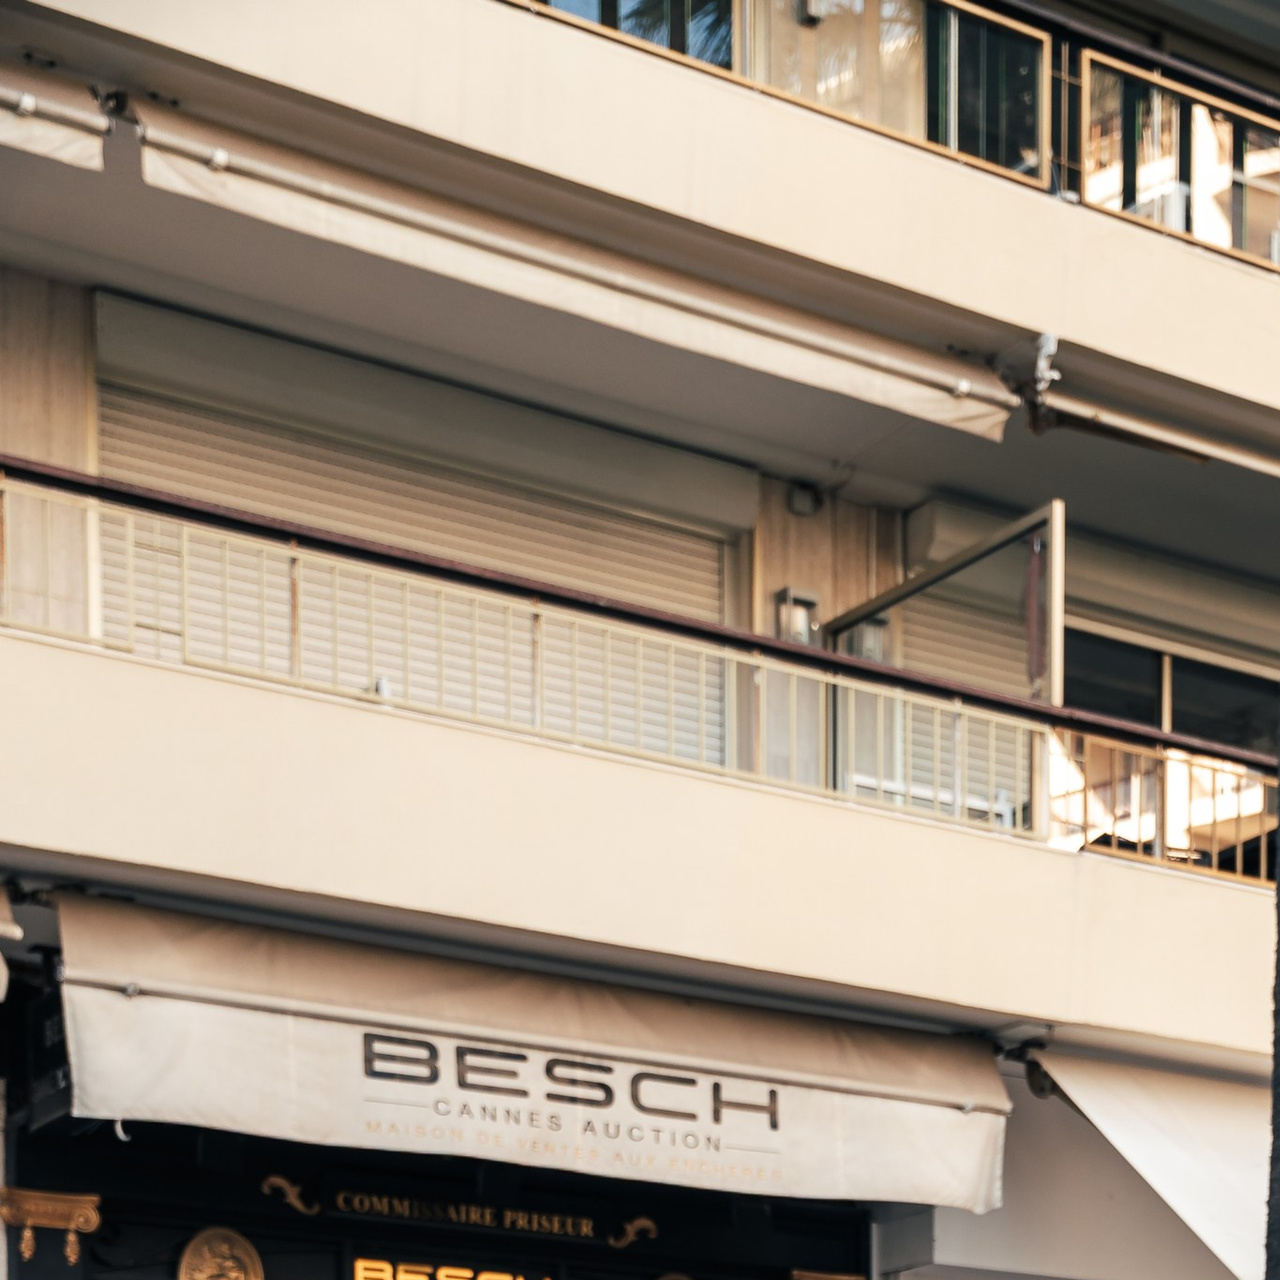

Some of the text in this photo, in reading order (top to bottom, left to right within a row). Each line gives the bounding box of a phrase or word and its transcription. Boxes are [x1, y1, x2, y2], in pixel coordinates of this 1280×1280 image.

[364, 1033, 779, 1130] BESCH
[364, 1120, 464, 1142] MAISON
[476, 1130, 503, 1147] DE
[517, 1138, 600, 1161] VENTES
[613, 1149, 656, 1168] AUX
[433, 1099, 722, 1153] CANNES AUCTION
[336, 1190, 594, 1238] COMMISSAIRE PRISEUR
